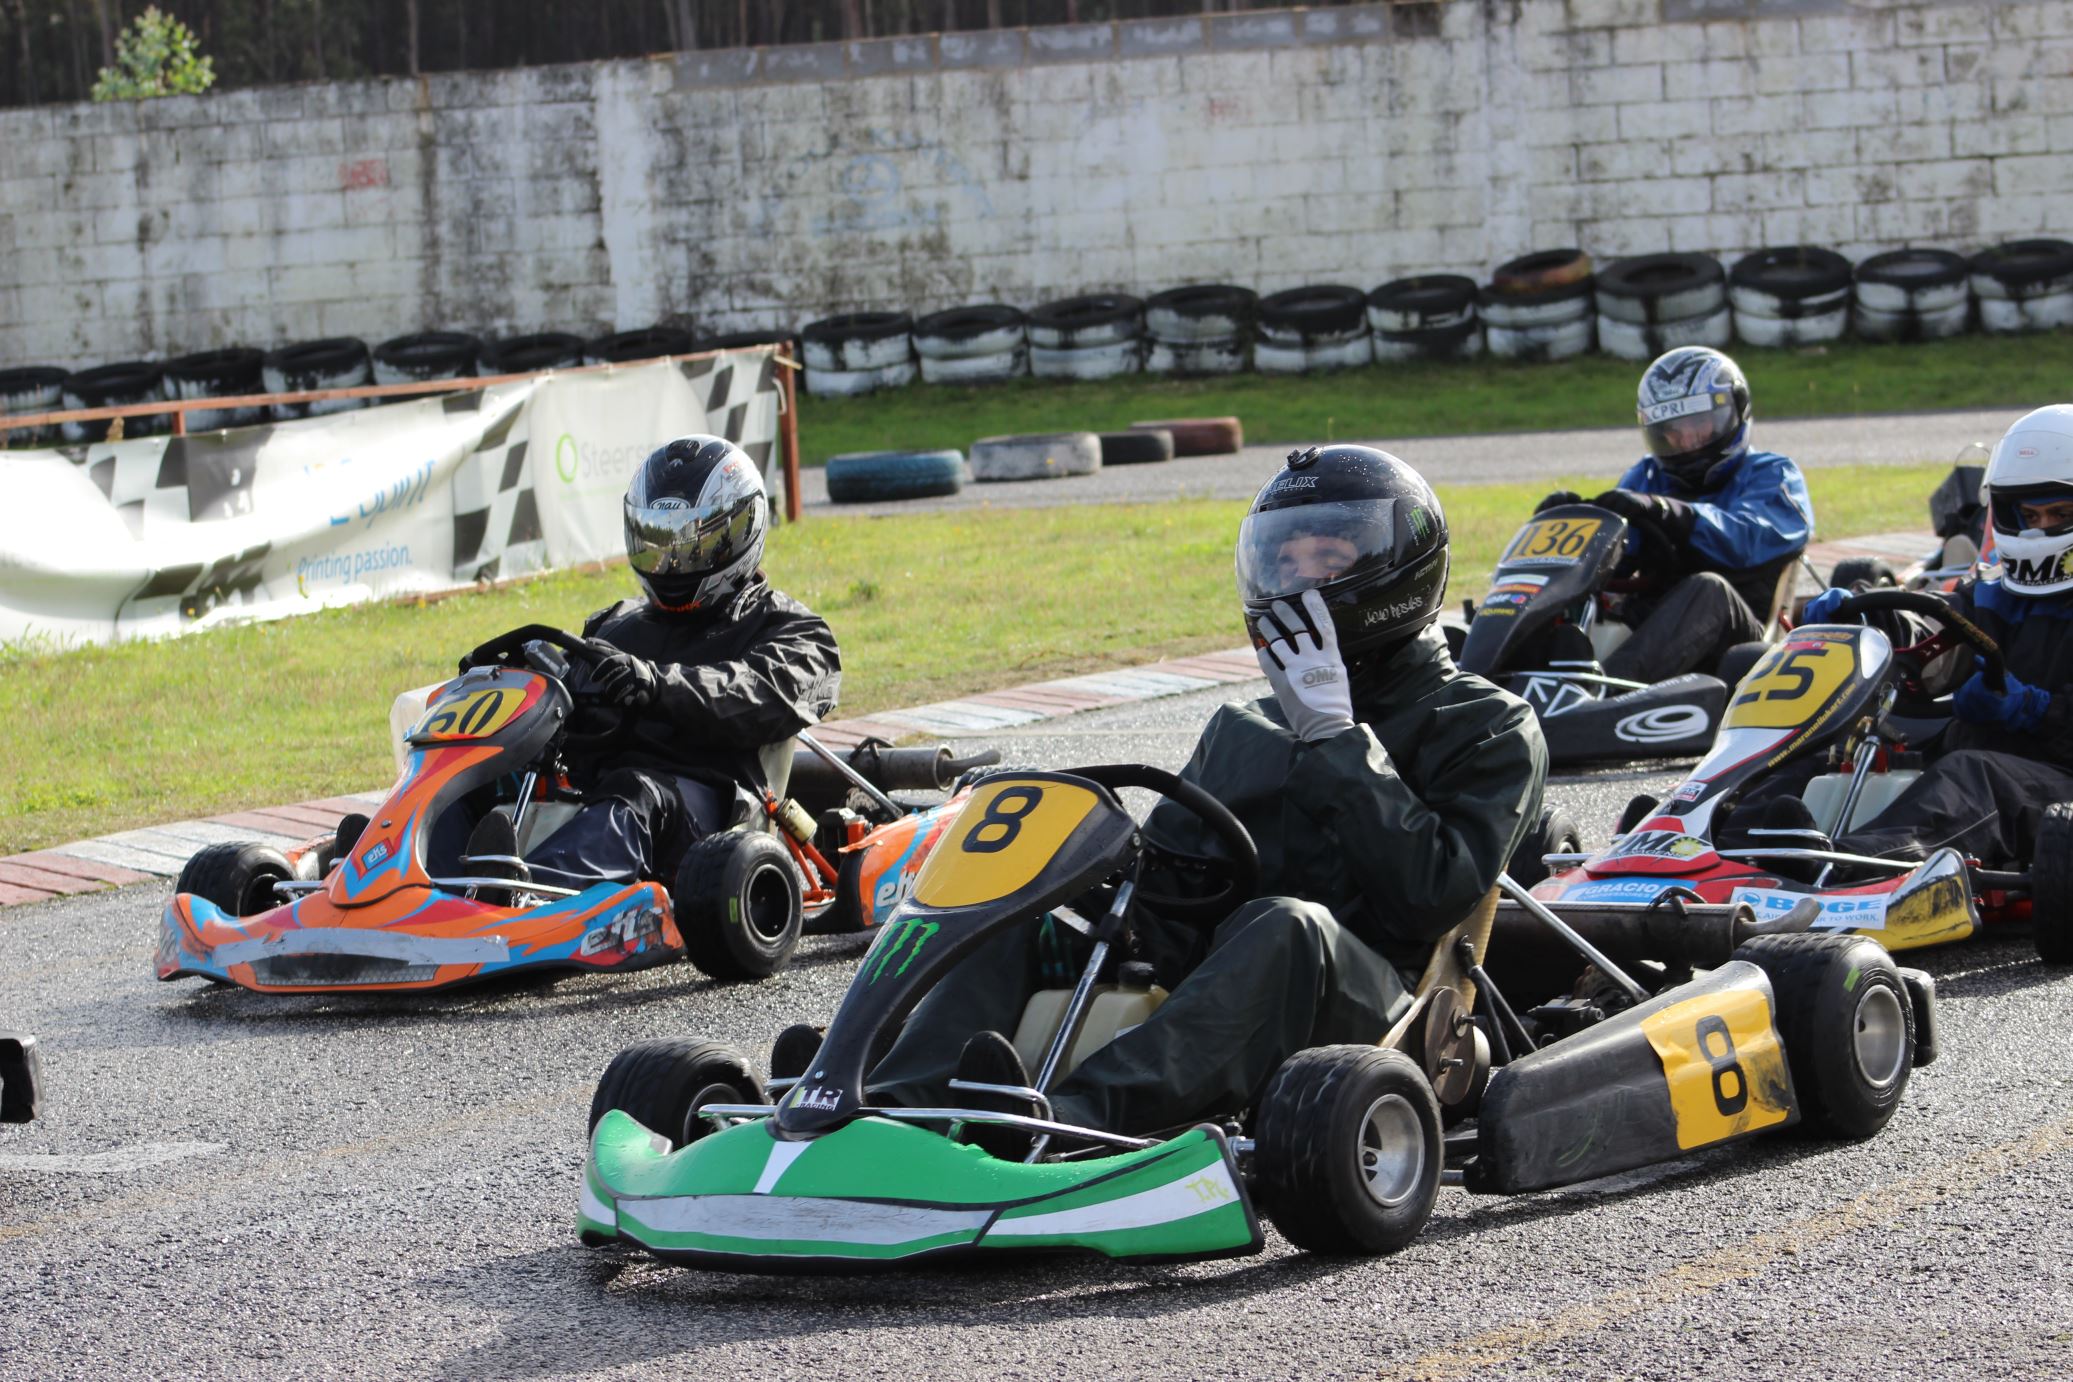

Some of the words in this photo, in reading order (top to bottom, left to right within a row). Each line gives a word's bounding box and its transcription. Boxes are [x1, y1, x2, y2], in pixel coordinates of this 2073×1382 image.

[297, 552, 351, 584] Printing
[354, 540, 412, 583] passion.
[1302, 668, 1337, 685] OMP
[962, 785, 1044, 853] 8
[1765, 896, 1881, 914] BGE
[1844, 912, 1880, 922] WORK.
[1695, 1014, 1748, 1117] 8
